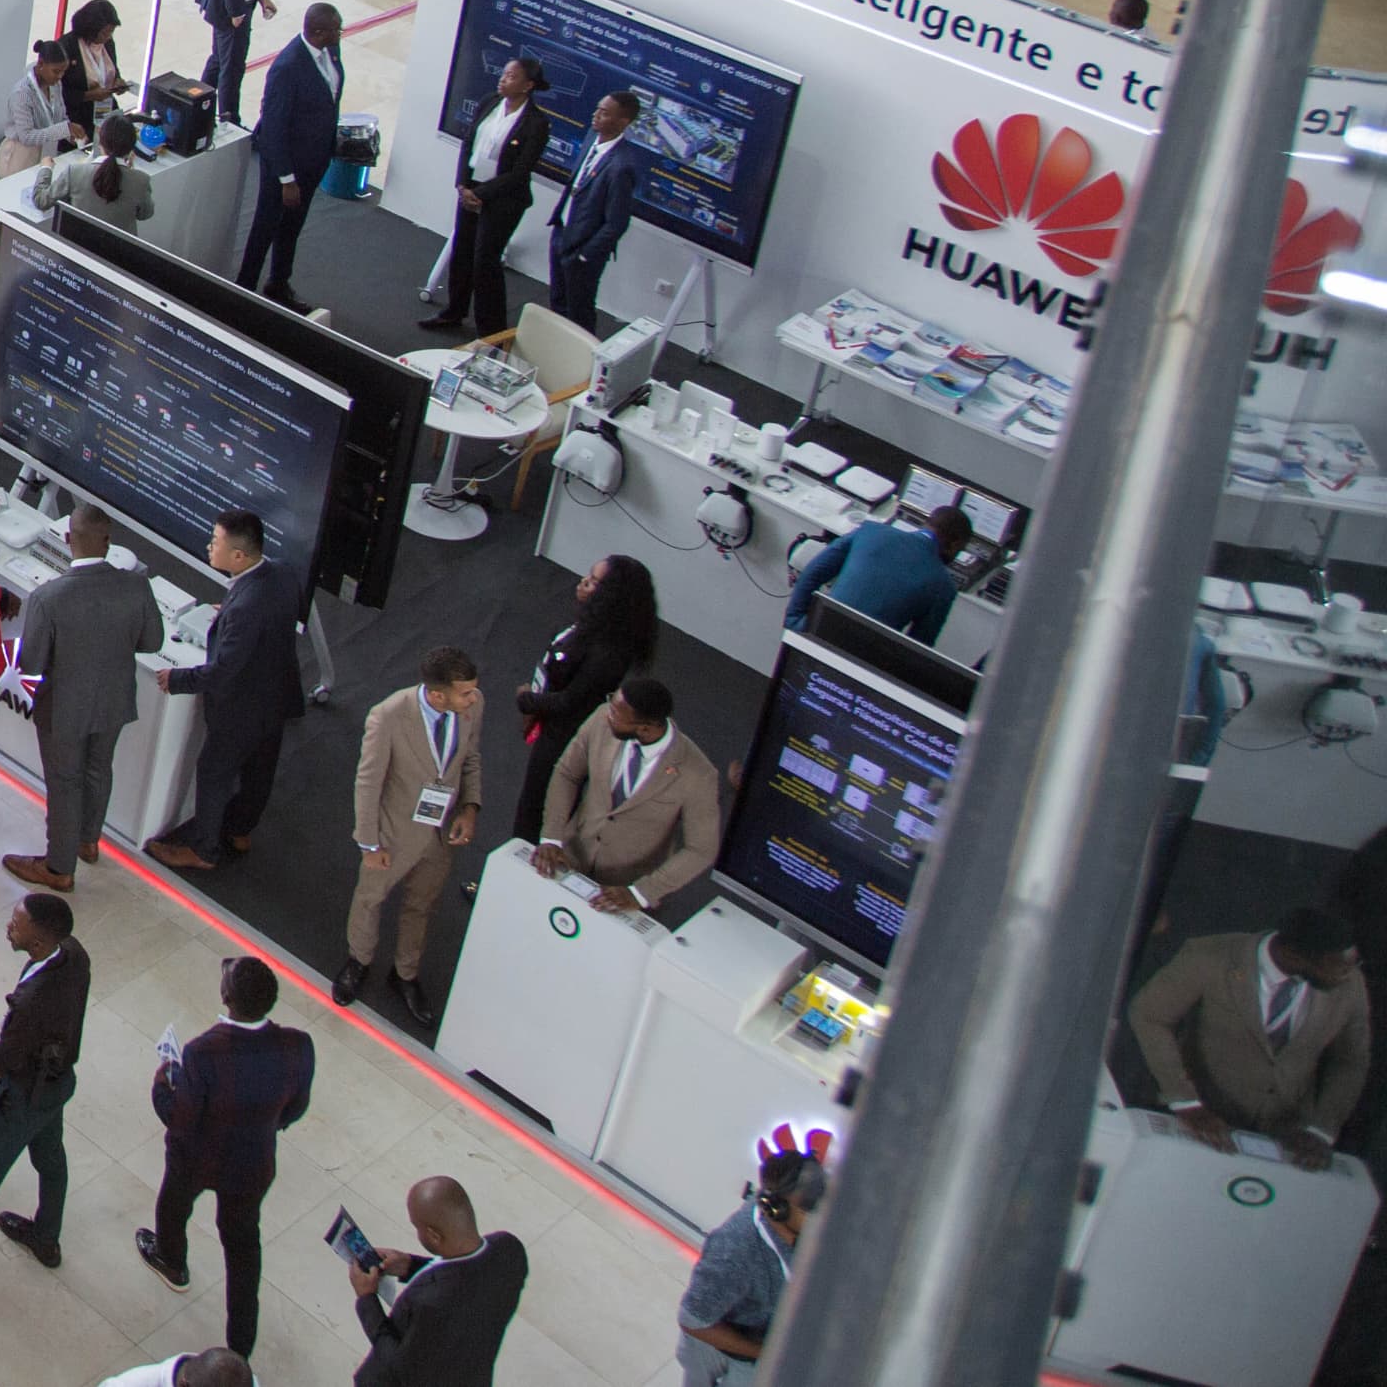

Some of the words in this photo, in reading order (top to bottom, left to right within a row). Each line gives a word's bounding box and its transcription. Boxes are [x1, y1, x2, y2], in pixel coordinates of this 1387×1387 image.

[542, 6, 556, 17] aos
[556, 11, 592, 32] negócios
[592, 25, 603, 35] do
[603, 29, 629, 46] futuro
[720, 62, 734, 75] DC
[734, 69, 772, 89] moderno
[1076, 62, 1103, 90] e
[10, 247, 49, 275] Manutenção
[50, 270, 61, 281] em
[61, 275, 81, 292] PMEs
[901, 227, 1093, 332] HUAWE
[11, 238, 29, 254] Rede
[47, 258, 57, 269] De
[58, 264, 85, 285] Campus
[86, 279, 119, 304] Pequenos,
[122, 299, 142, 316] Micro
[149, 313, 175, 335] Médios,
[176, 329, 204, 350] Melhore
[211, 348, 246, 374] Conexão,
[246, 367, 284, 395] Instalação
[805, 679, 853, 713] Seguras,
[852, 704, 891, 732] Fiáveis
[809, 670, 854, 700] Centrais
[854, 694, 927, 739] Fotovoltaicas
[927, 732, 943, 748] de
